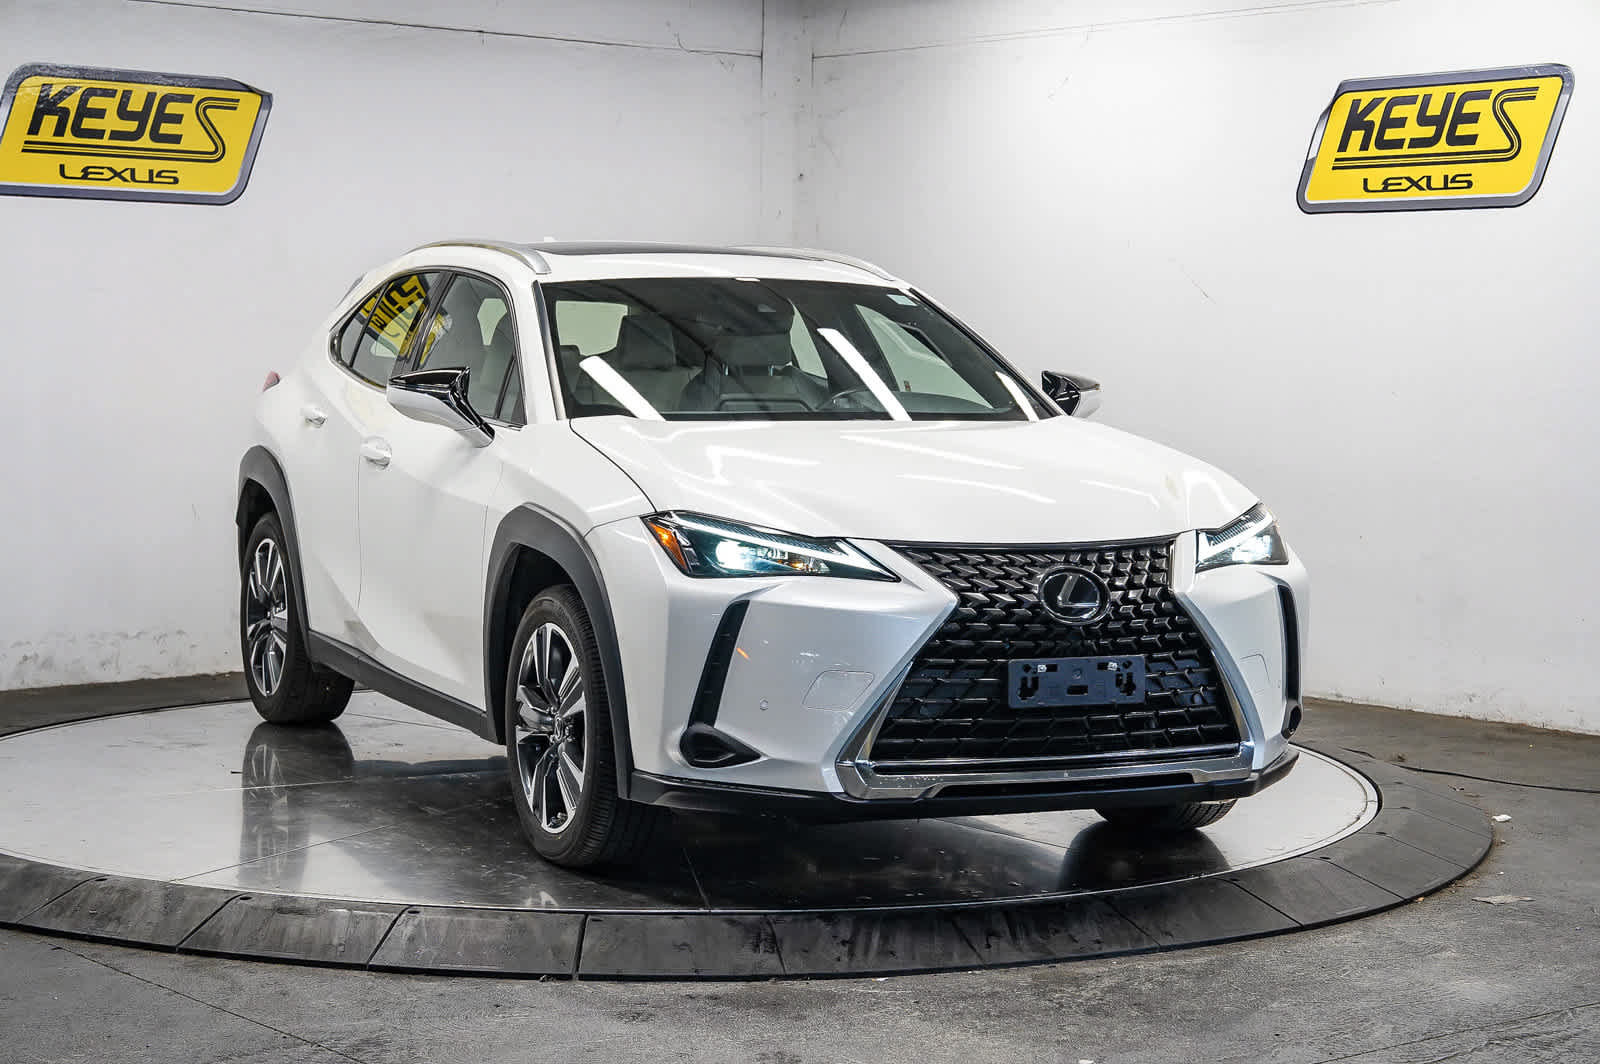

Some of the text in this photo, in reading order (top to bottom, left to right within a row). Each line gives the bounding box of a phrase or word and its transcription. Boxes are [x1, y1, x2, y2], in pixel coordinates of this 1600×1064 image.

[22, 83, 240, 163] KEYES
[1332, 87, 1539, 170] KEYES
[59, 164, 180, 185] LEXUS
[1362, 173, 1473, 193] LEXUS
